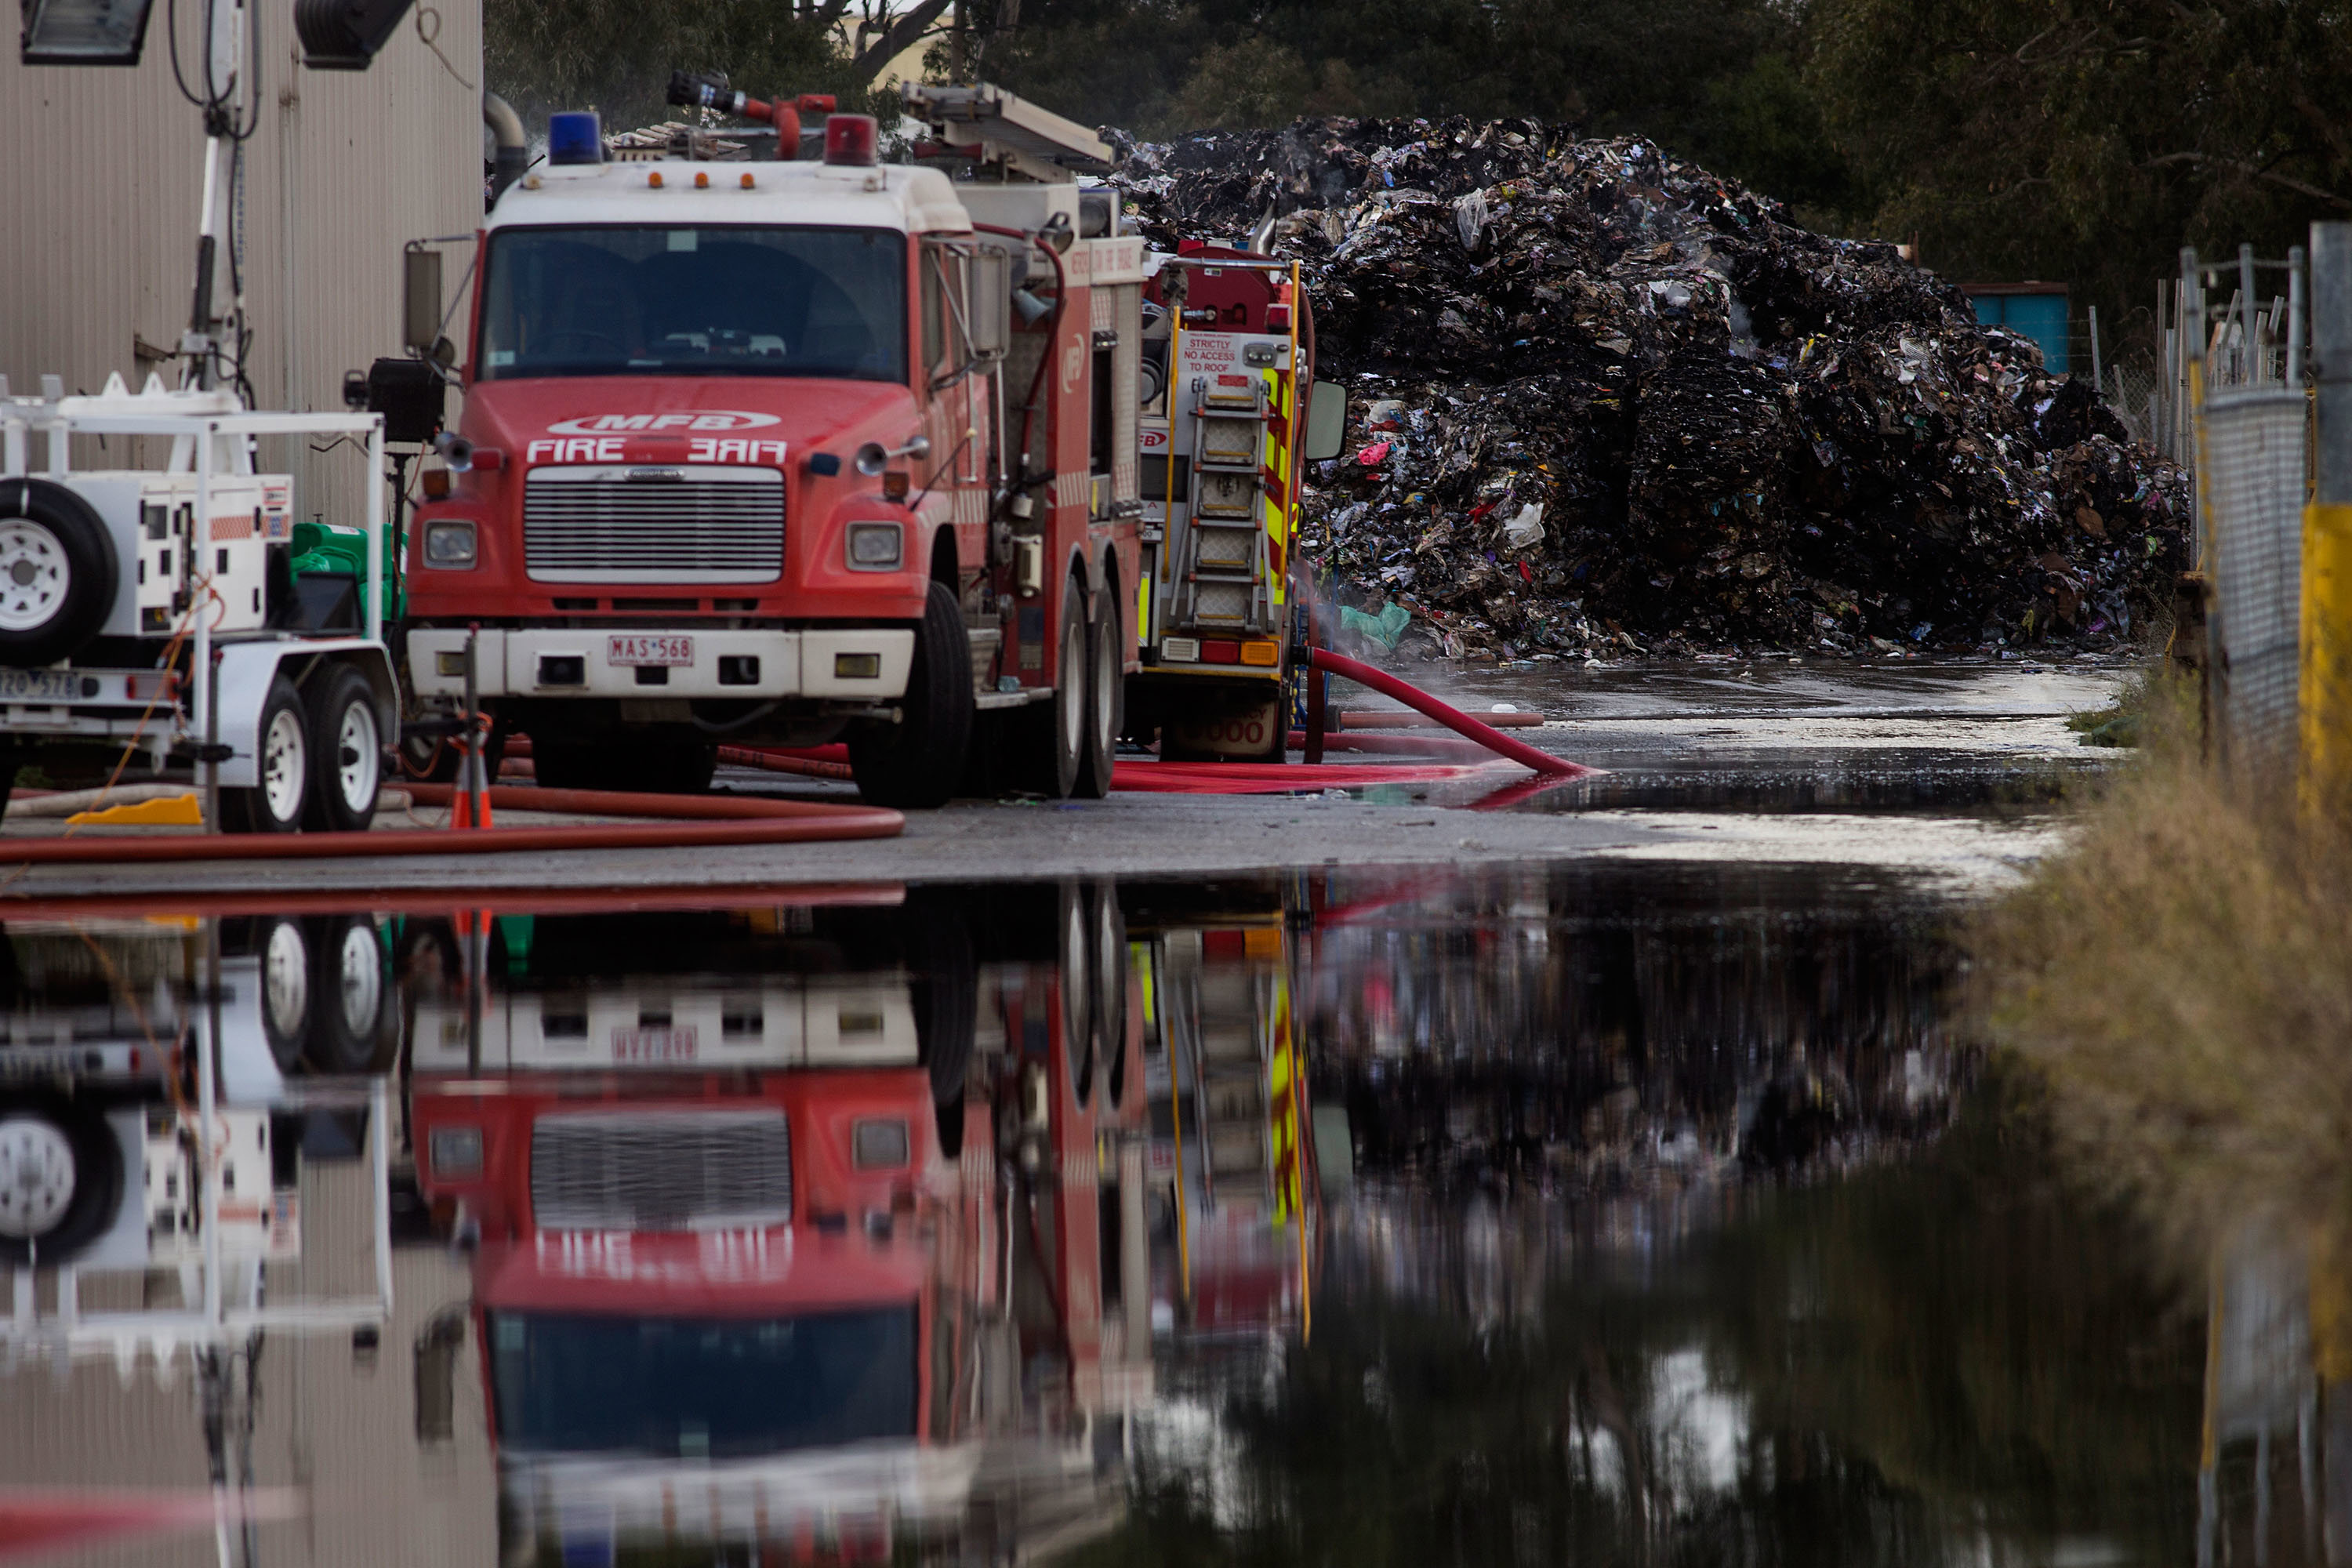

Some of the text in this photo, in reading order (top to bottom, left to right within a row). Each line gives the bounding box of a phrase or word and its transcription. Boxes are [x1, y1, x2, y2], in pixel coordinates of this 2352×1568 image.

[1190, 339, 1230, 349] STRICTLY
[1184, 350, 1236, 361] NO ACCESS
[1189, 362, 1229, 372] TO ROOF
[593, 414, 737, 430] MFB
[526, 437, 627, 463] FIRE
[612, 639, 690, 658] MAS 568
